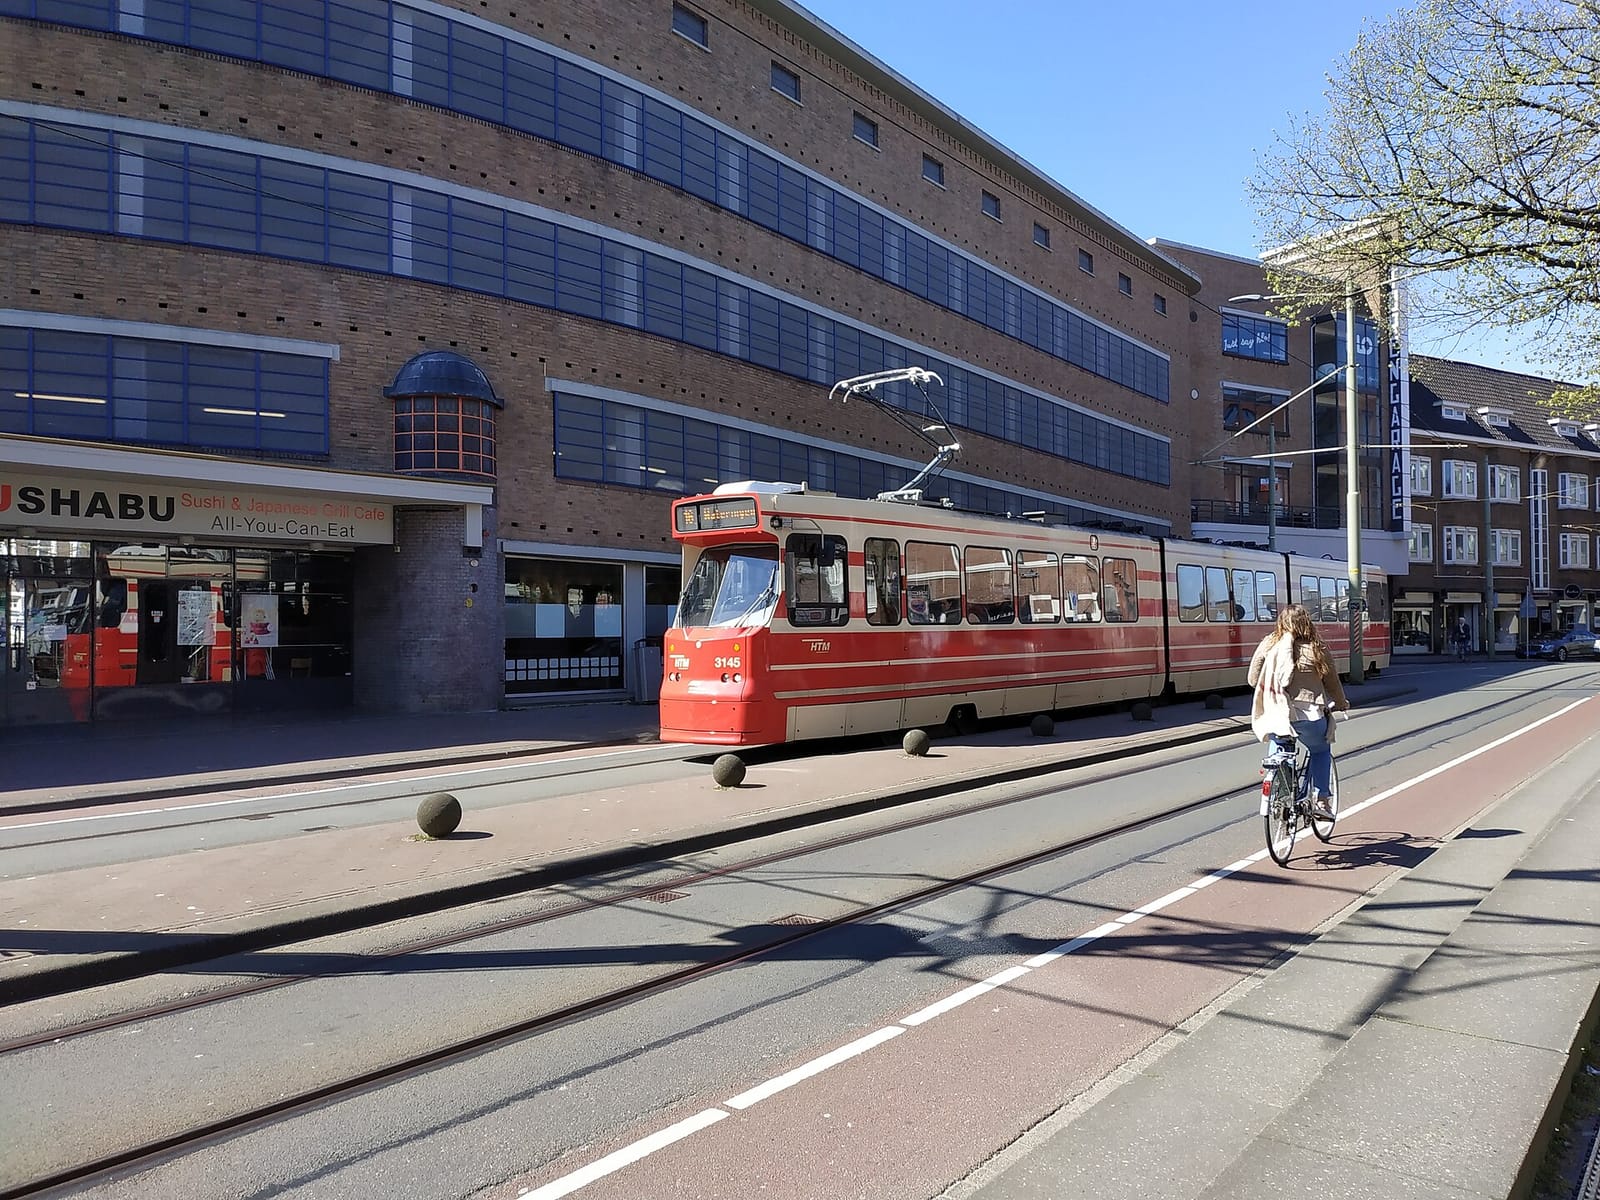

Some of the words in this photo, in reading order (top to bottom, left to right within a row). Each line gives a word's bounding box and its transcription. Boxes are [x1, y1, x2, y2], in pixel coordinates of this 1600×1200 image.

[181, 493, 225, 509] Sushi
[231, 497, 241, 510] &
[247, 498, 317, 516] Japanese
[322, 504, 349, 518] Grill
[354, 507, 385, 520] Cafe
[211, 515, 355, 538] All-You-Can-Eat
[810, 642, 830, 651] HTM
[714, 657, 741, 668] 3145
